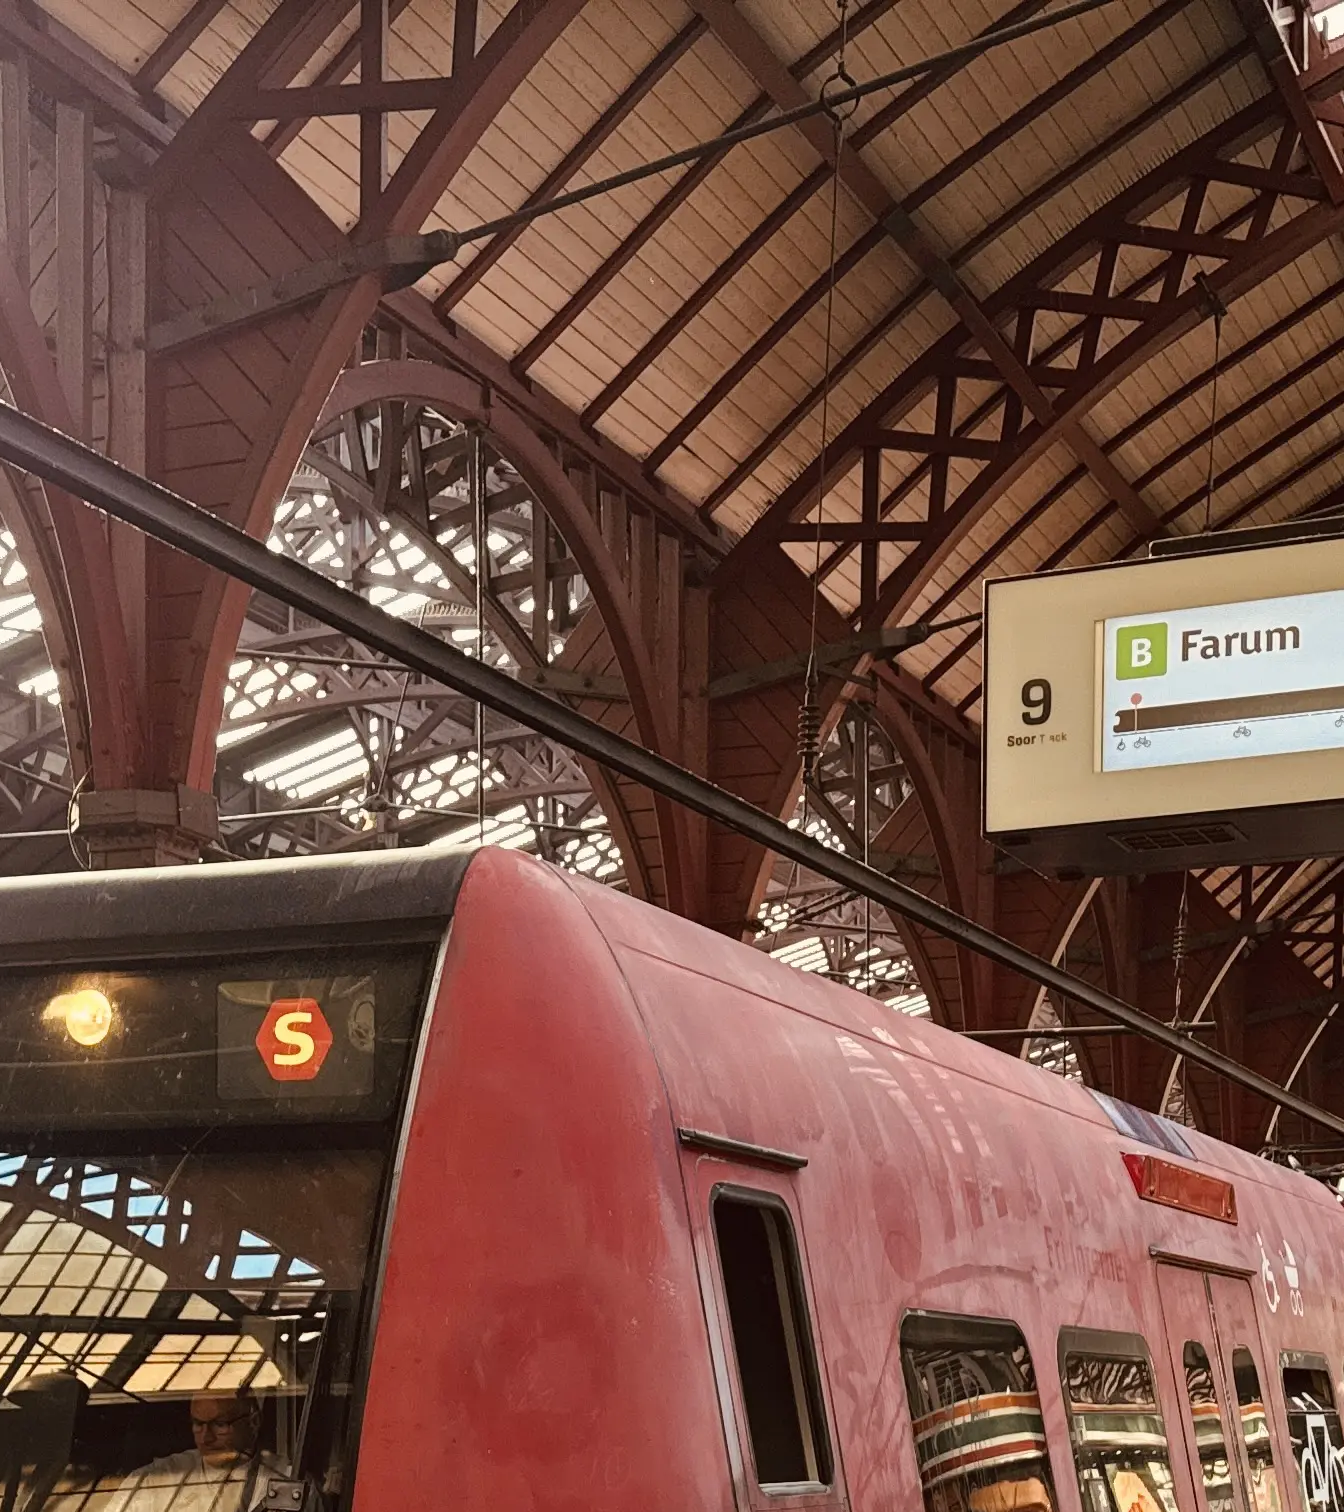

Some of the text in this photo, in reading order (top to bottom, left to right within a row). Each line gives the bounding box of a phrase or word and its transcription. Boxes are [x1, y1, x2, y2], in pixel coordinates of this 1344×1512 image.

[1131, 625, 1300, 668] B Farum
[1021, 678, 1052, 726] 9
[273, 1011, 315, 1066] S
